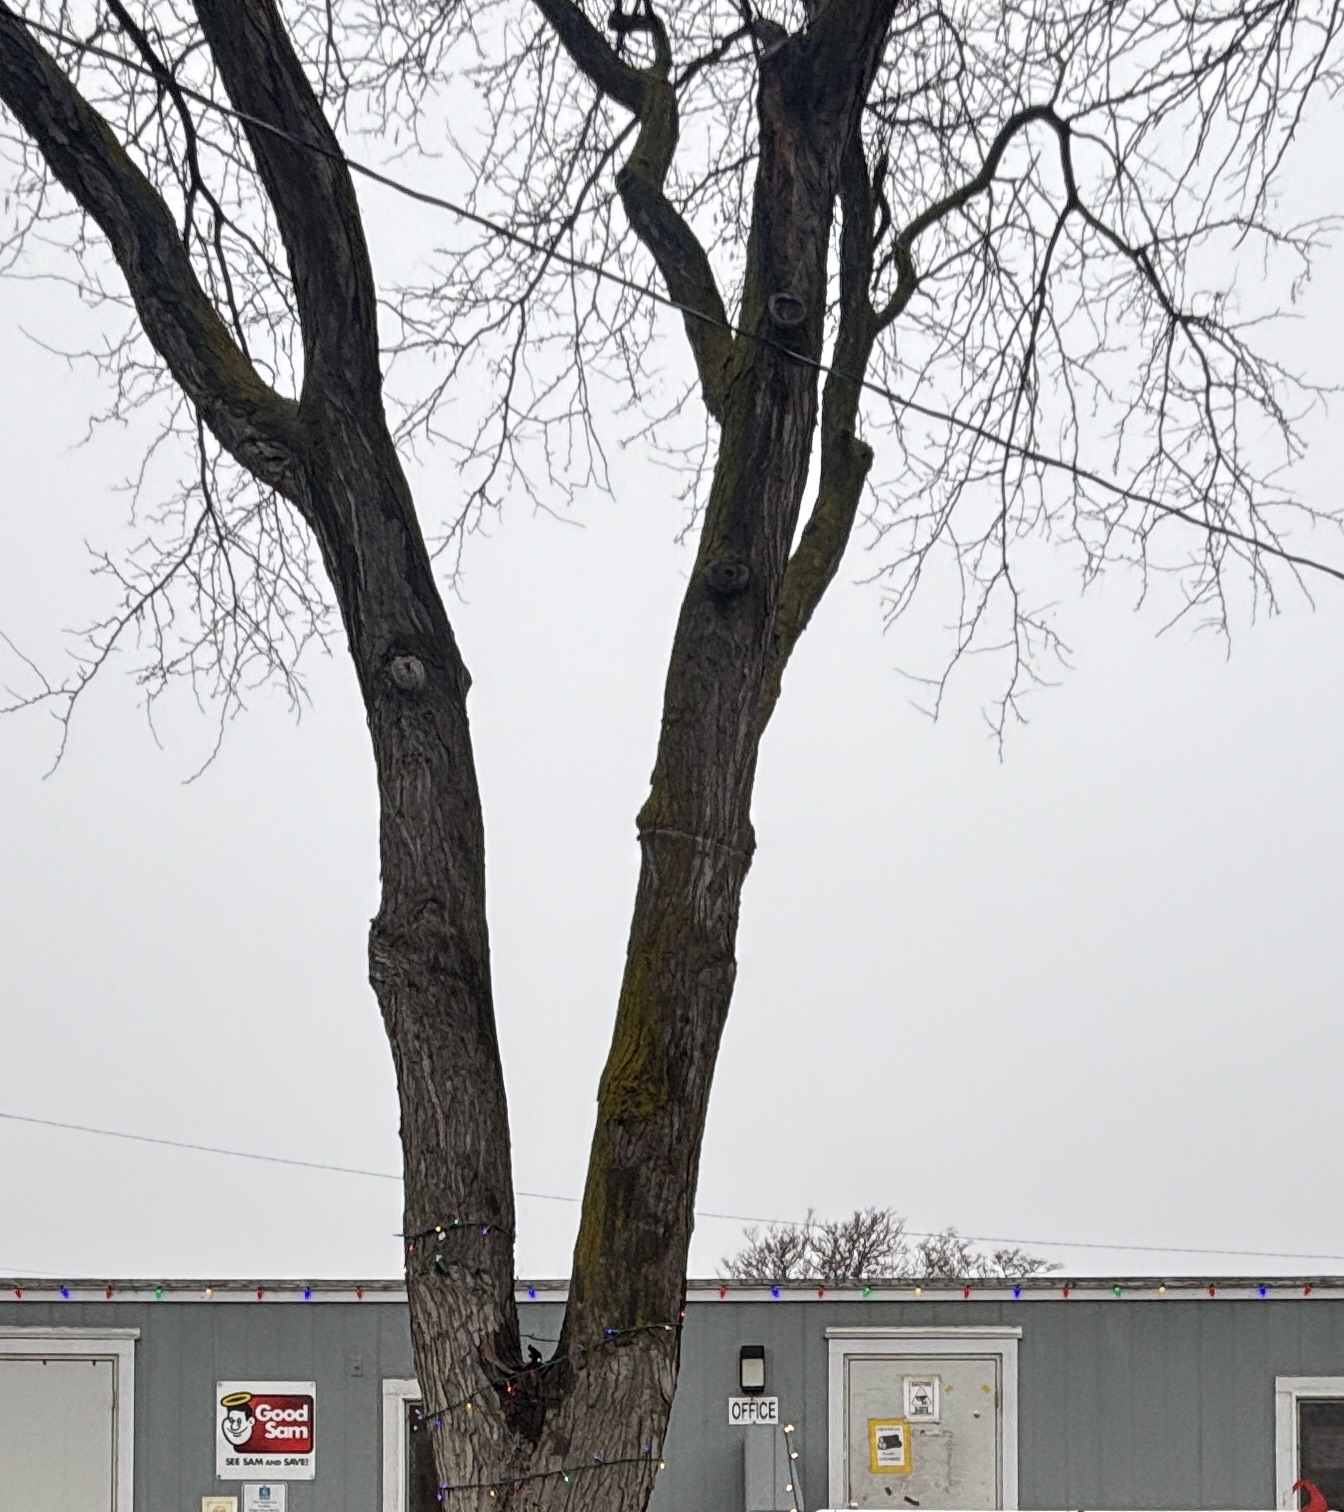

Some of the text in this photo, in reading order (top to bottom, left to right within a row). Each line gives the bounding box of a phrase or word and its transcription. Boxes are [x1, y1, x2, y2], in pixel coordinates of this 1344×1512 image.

[255, 1404, 309, 1422] Good
[731, 1401, 776, 1420] OFFICE
[264, 1421, 309, 1439] Sam
[225, 1457, 240, 1466] SEE
[243, 1457, 263, 1466] SAM
